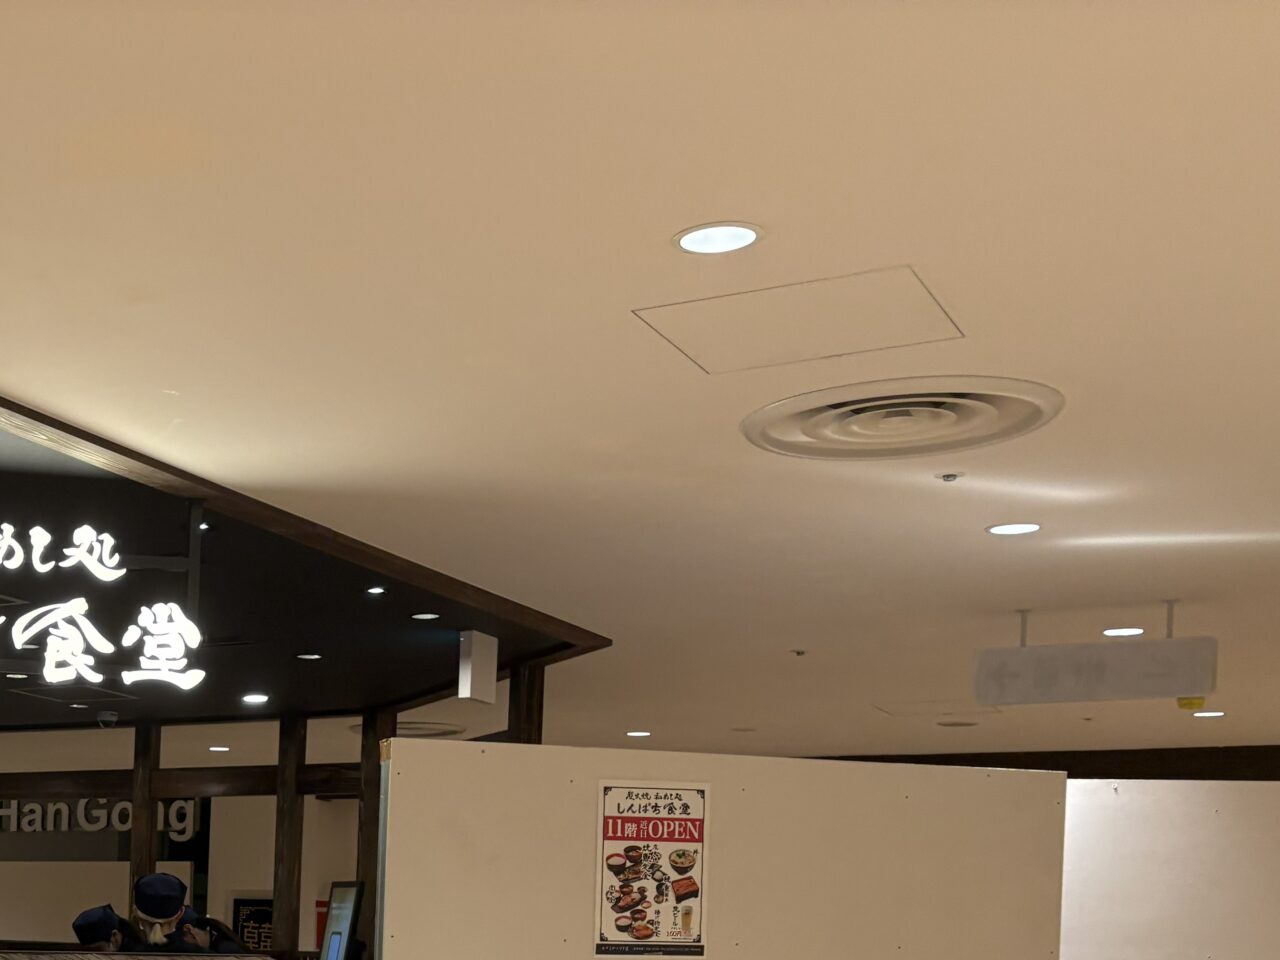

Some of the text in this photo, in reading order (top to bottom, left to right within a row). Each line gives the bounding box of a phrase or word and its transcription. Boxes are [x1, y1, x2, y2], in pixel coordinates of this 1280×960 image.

[617, 802, 691, 816] しんぱち食堂
[648, 820, 701, 840] OPEN
